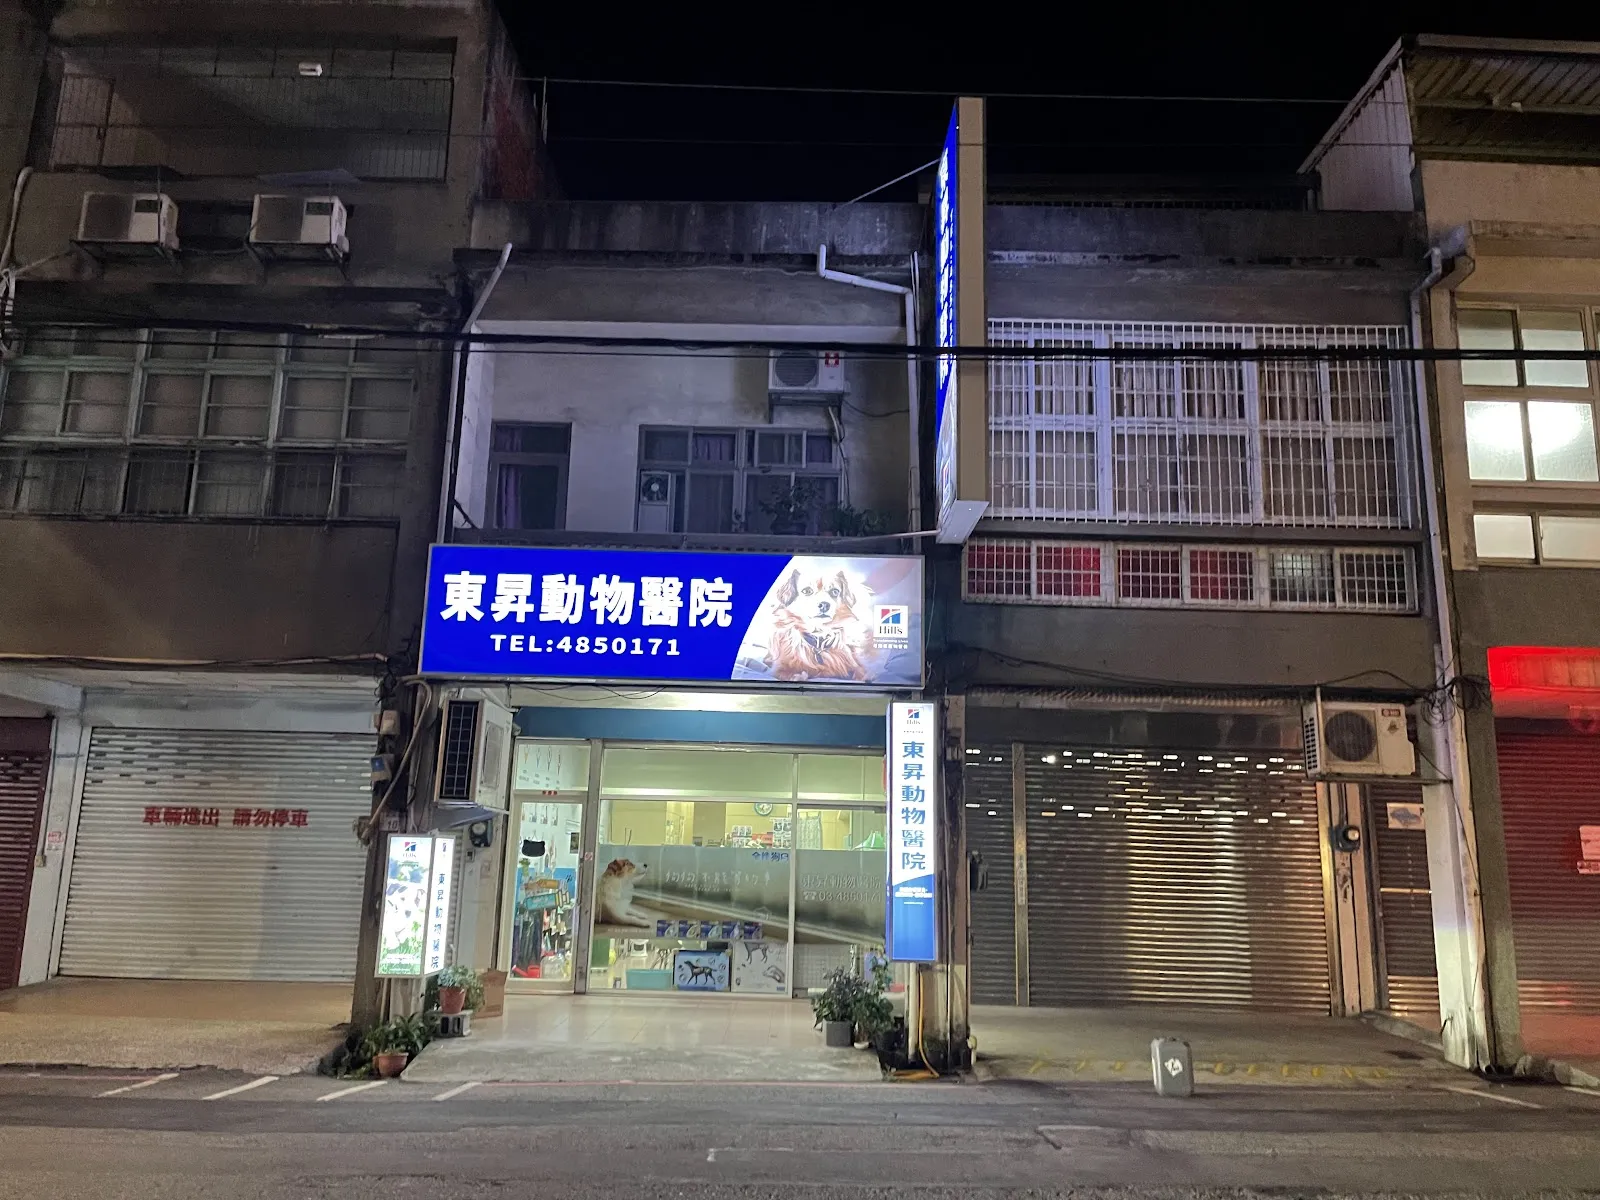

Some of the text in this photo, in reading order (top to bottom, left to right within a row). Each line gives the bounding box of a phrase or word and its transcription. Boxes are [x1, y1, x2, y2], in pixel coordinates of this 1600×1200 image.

[440, 570, 733, 628] 東昇動物醫院
[490, 634, 681, 656] TEL:4850171
[143, 806, 309, 828] 車輛進出 請勿停車
[901, 740, 926, 870] 東昇動物醫院
